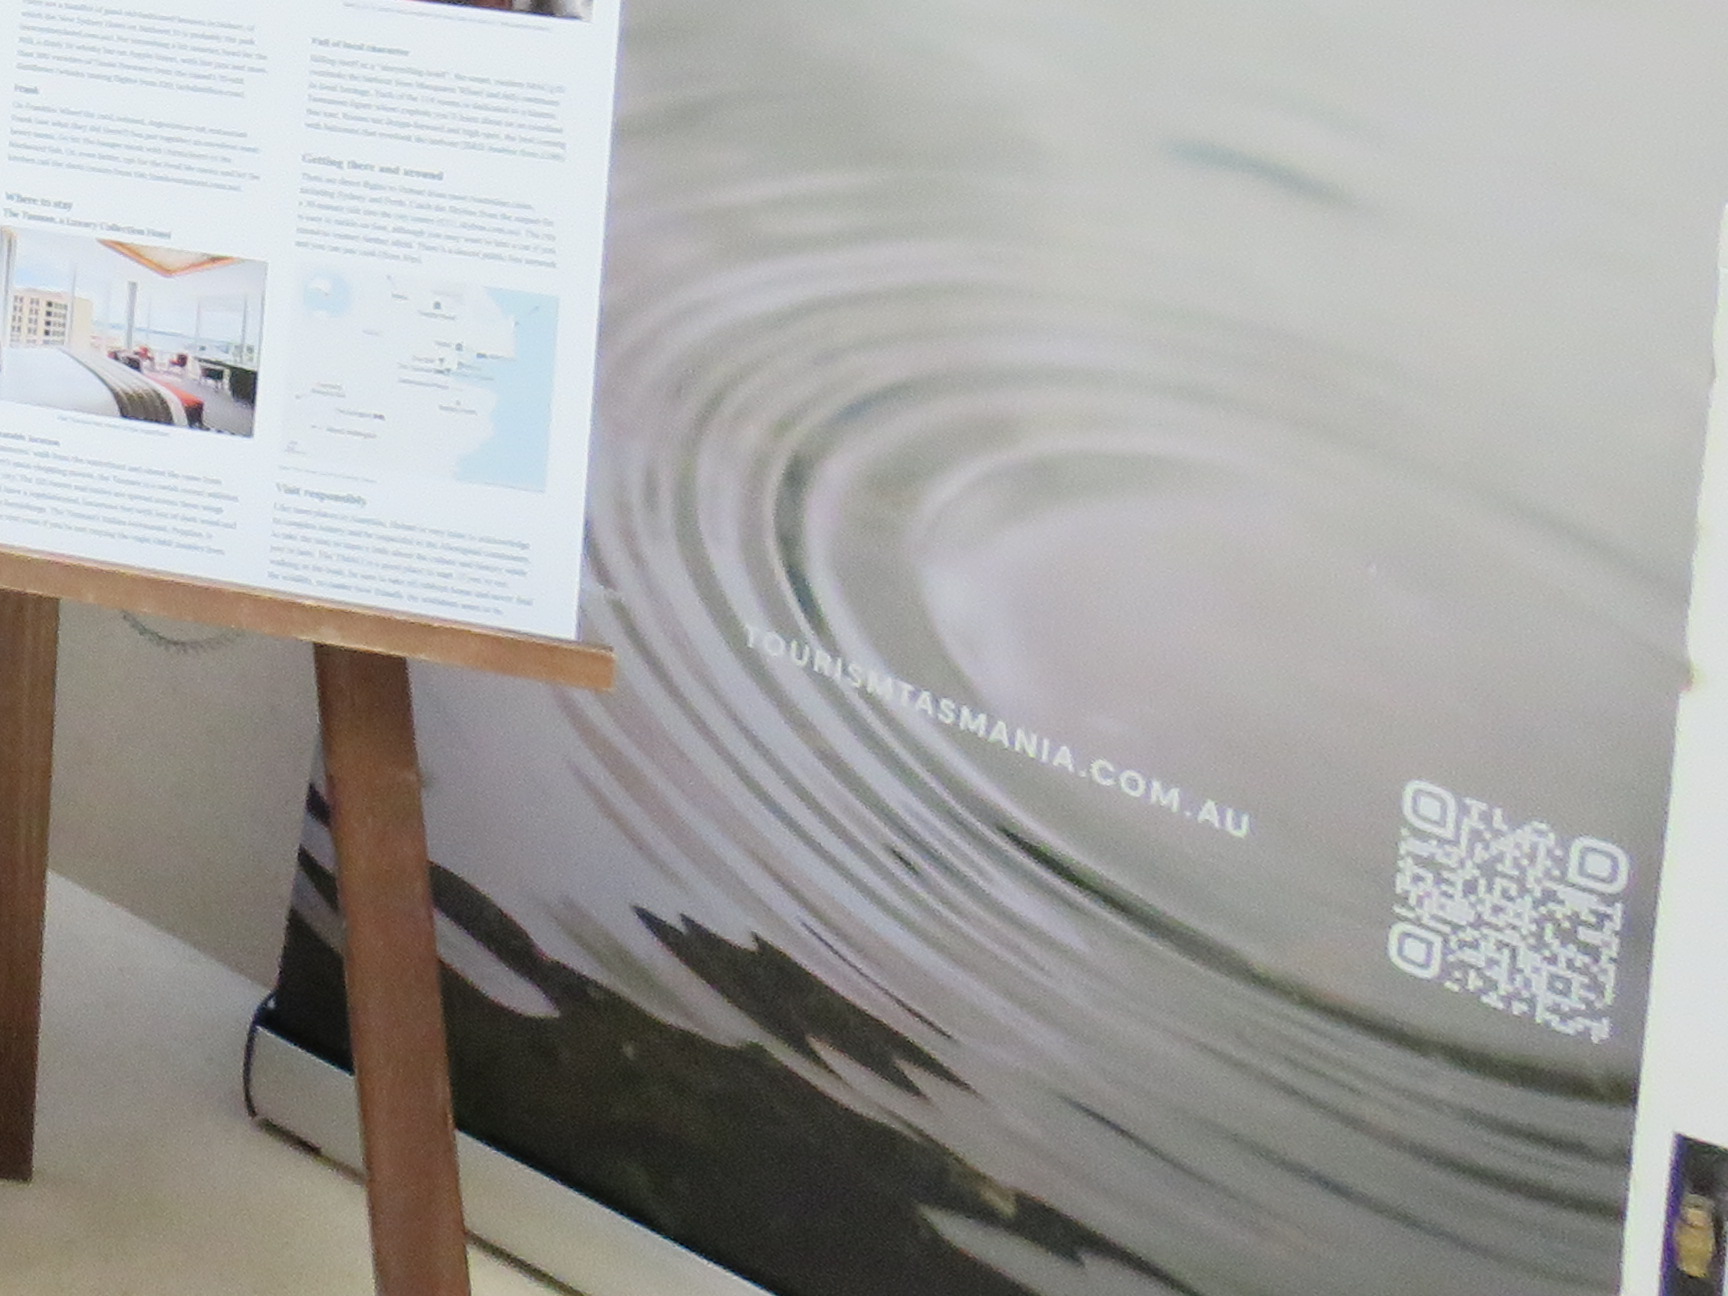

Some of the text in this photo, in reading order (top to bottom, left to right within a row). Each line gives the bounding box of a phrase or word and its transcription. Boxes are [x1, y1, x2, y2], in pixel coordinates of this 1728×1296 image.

[5, 192, 38, 205] Where
[52, 200, 72, 210] stay
[745, 626, 1250, 839] TOURISMTASMANIA.COM.AU
